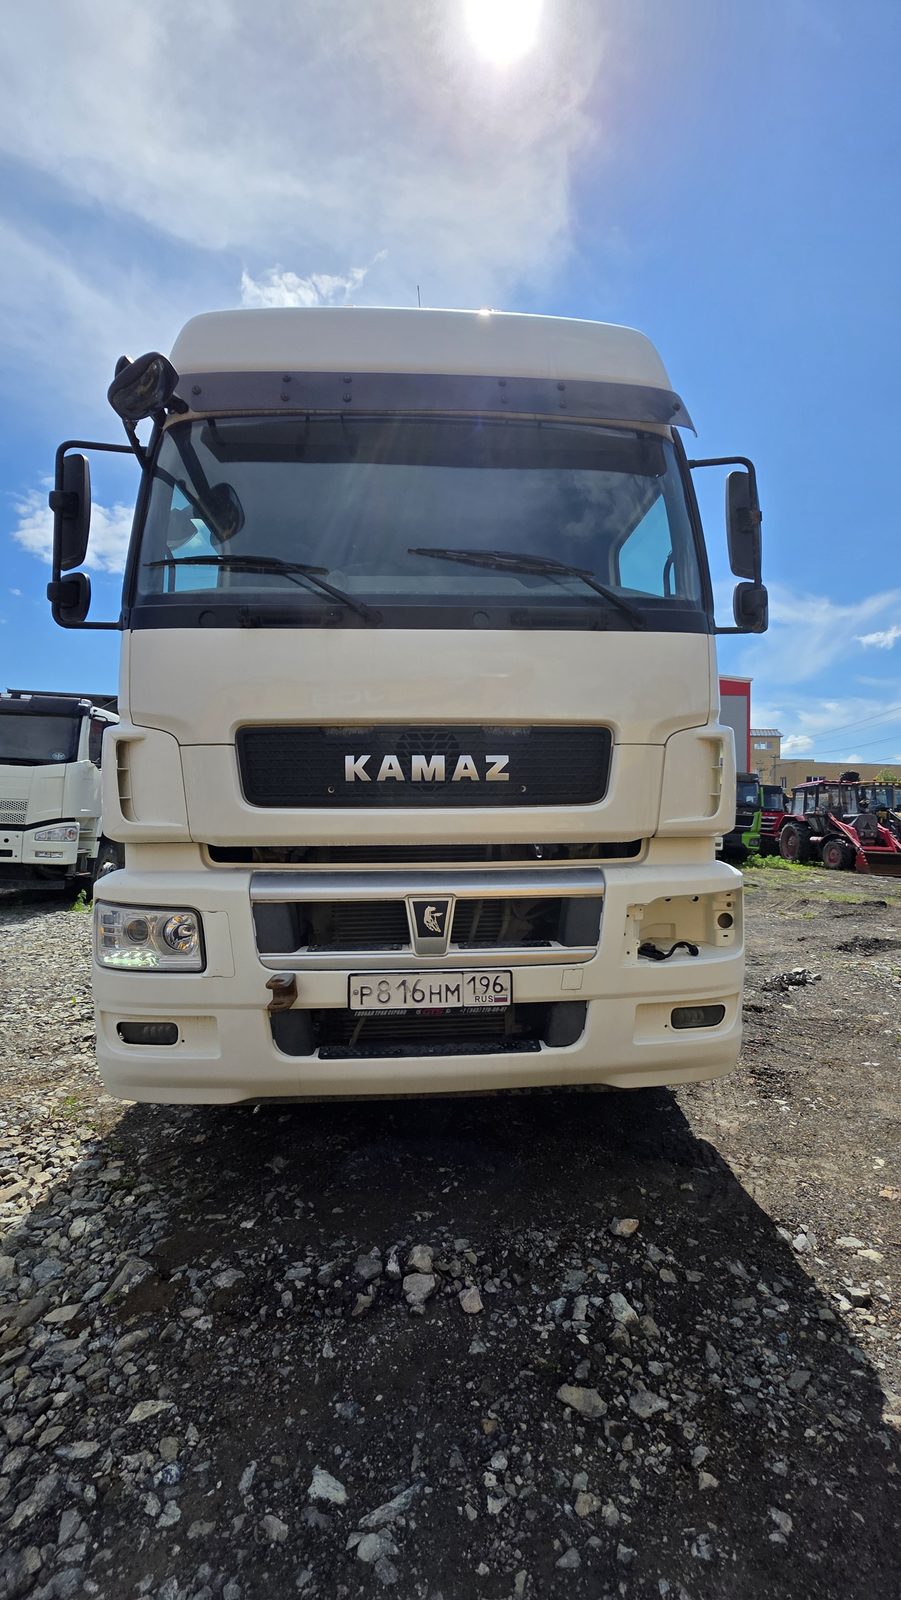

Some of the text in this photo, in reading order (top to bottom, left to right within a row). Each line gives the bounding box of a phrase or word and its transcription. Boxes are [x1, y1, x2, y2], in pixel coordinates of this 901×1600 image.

[345, 755, 510, 782] KAMAZ
[466, 975, 504, 996] 196
[475, 995, 494, 1003] RUS
